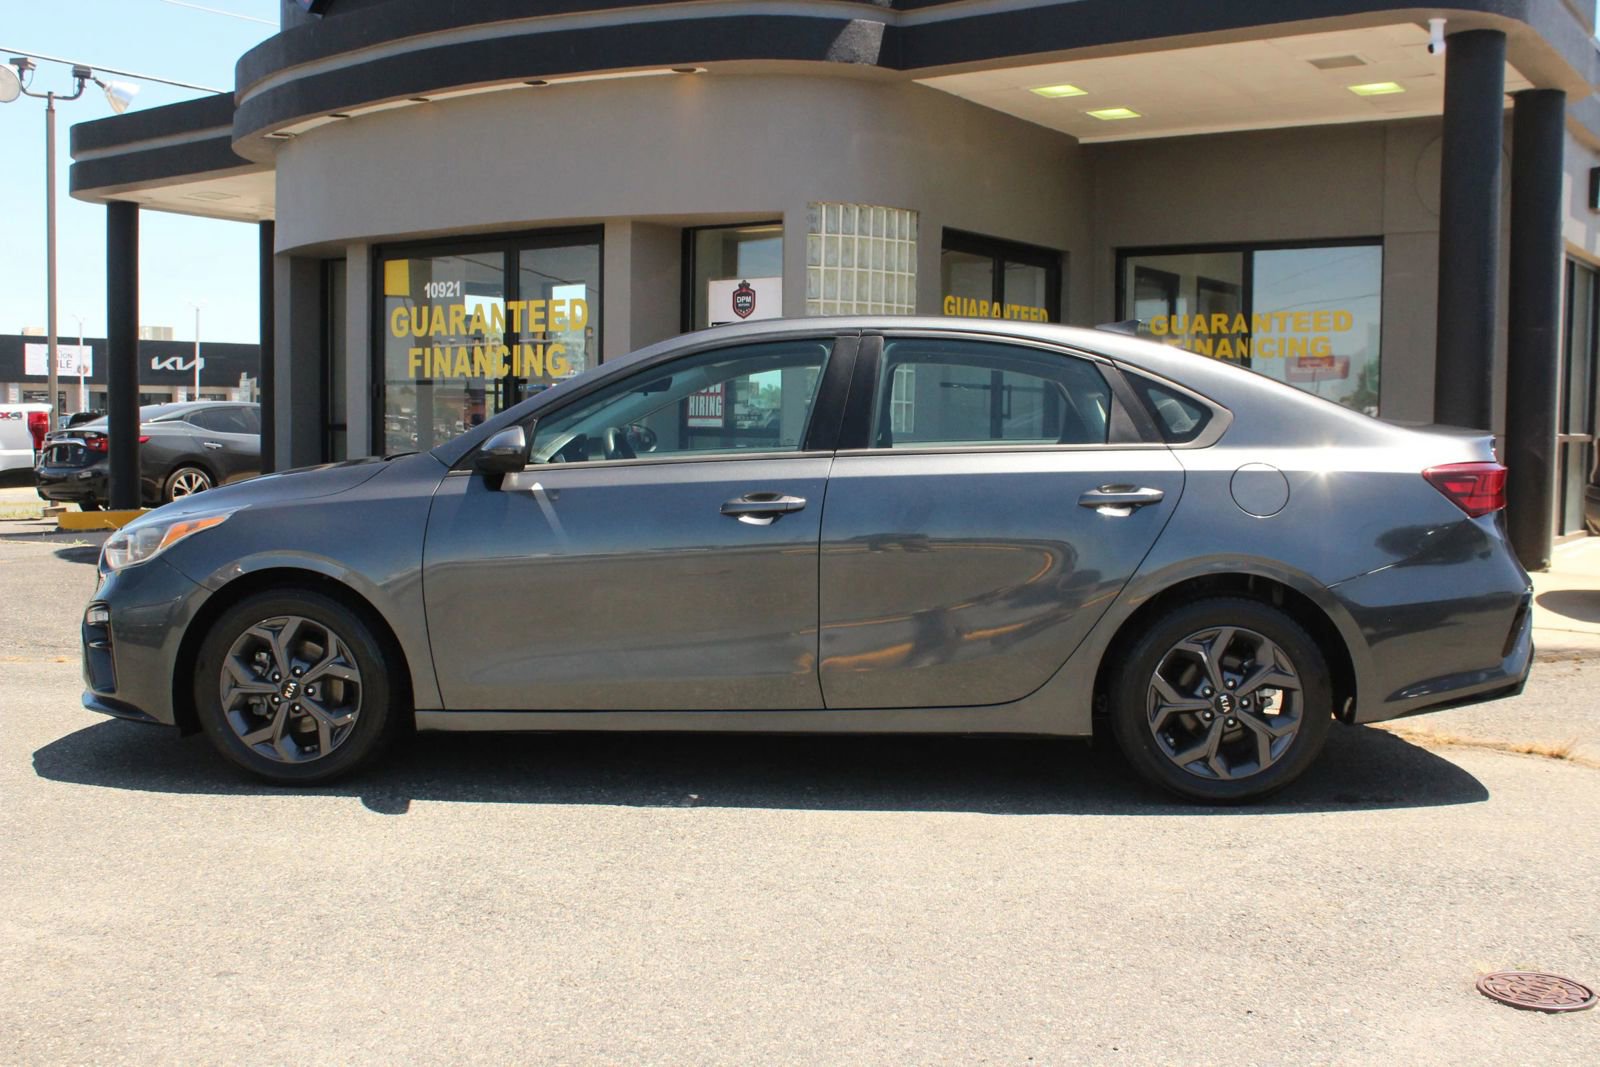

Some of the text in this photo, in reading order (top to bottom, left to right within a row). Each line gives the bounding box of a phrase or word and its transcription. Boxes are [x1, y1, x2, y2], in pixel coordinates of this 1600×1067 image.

[424, 281, 461, 299] 10921
[391, 299, 588, 338] GUARANTEED
[1149, 310, 1354, 336] GUARANTEED
[408, 344, 569, 378] FINANCING
[688, 395, 722, 417] HIRING
[284, 683, 297, 697] KIA
[1219, 695, 1230, 711] KIA
